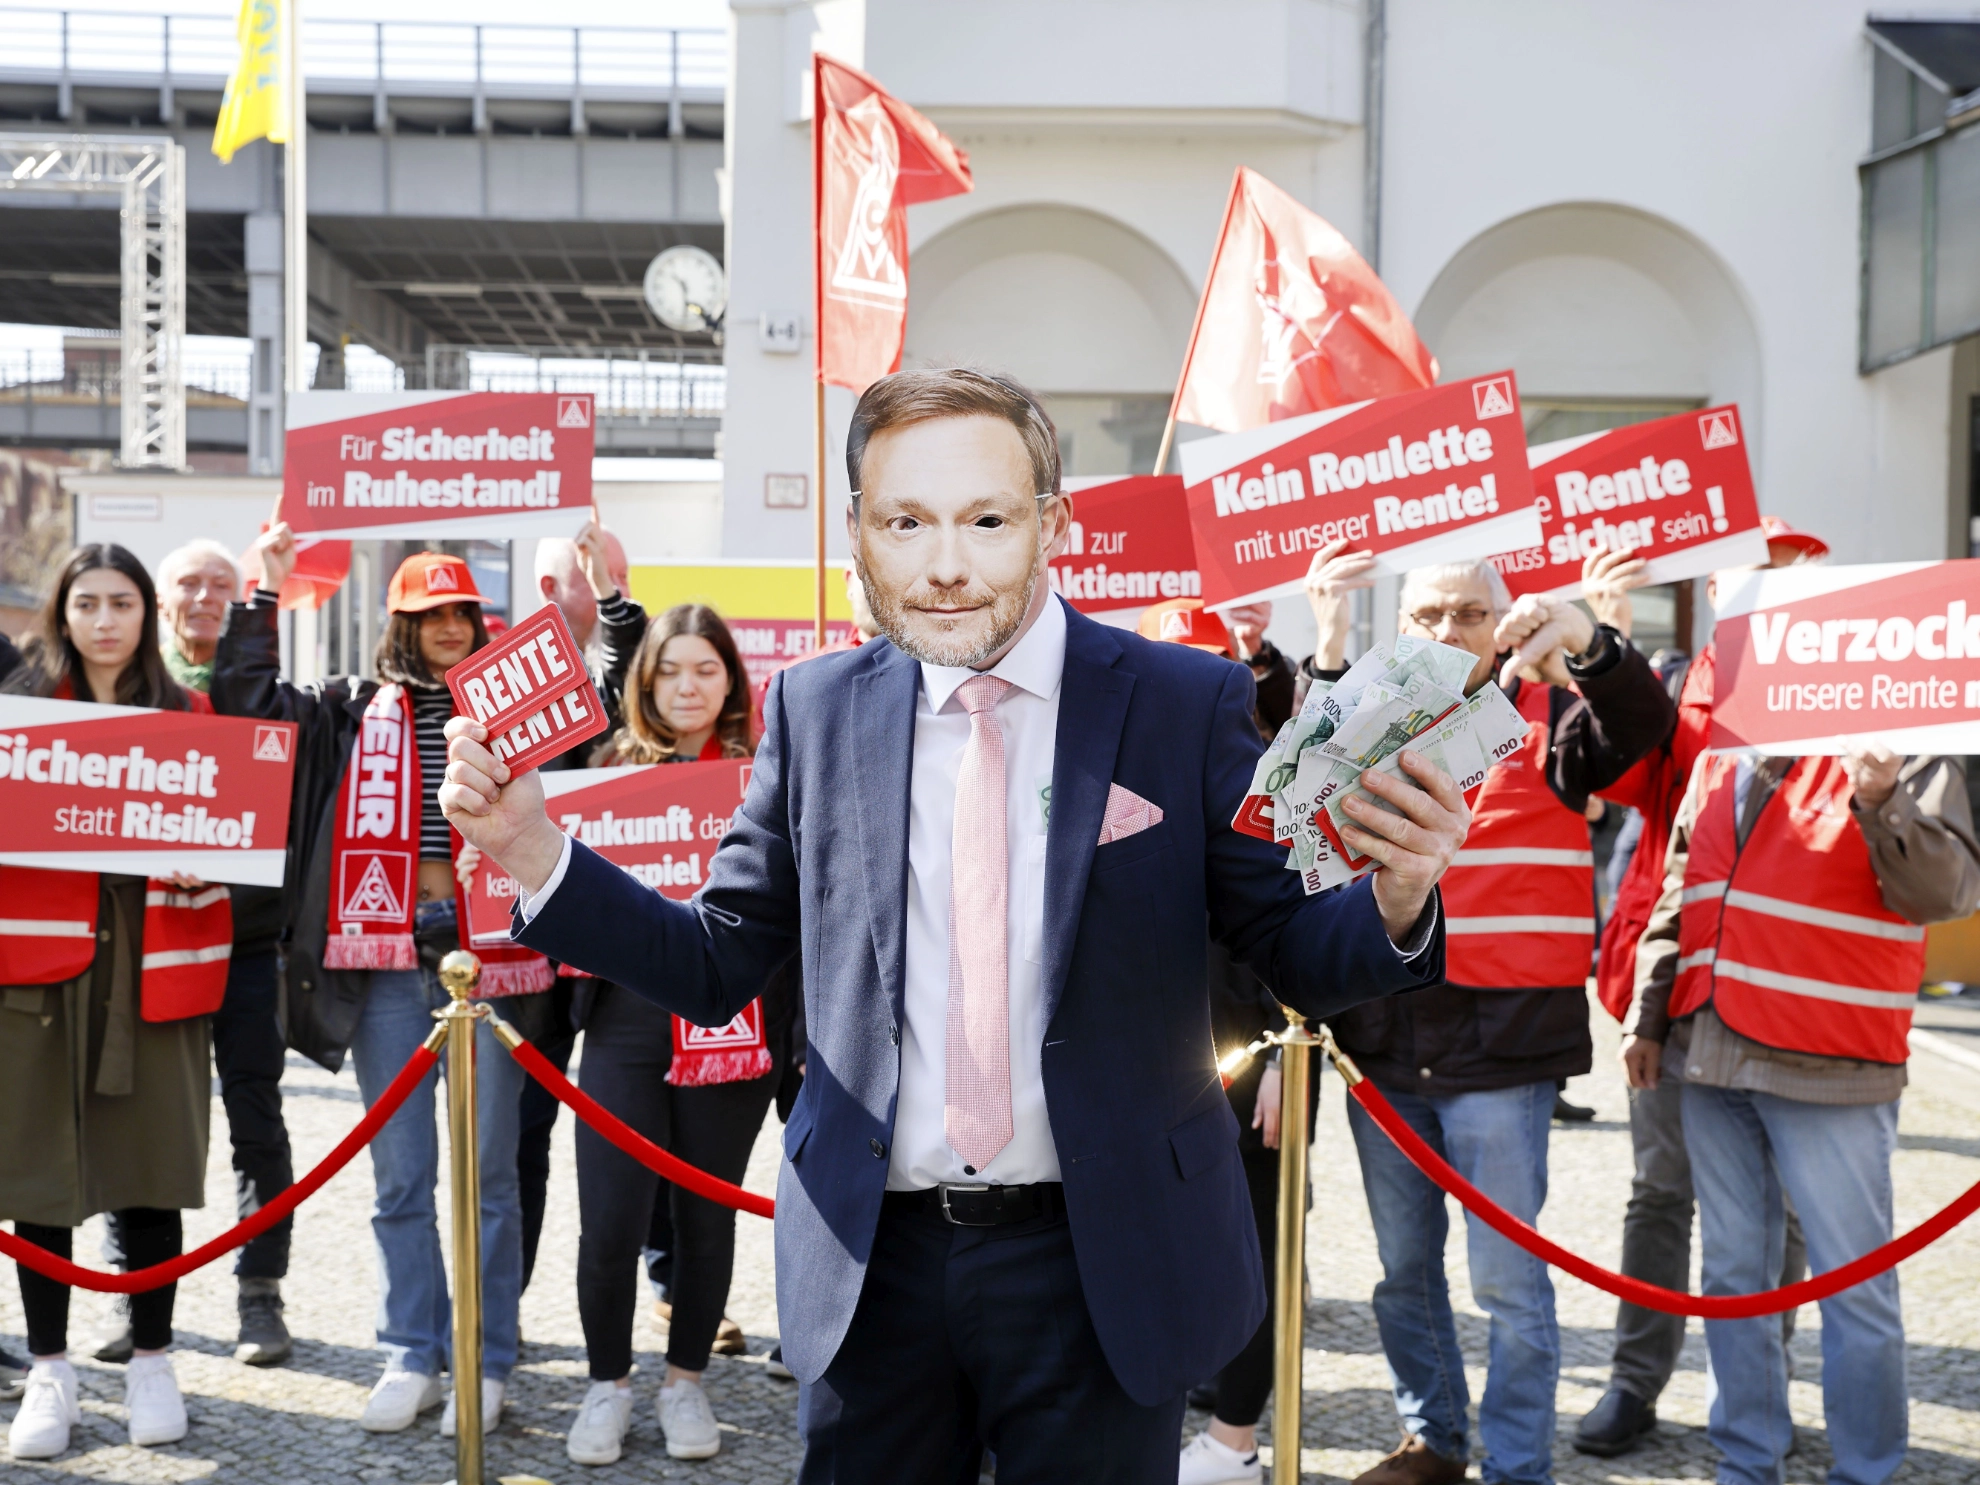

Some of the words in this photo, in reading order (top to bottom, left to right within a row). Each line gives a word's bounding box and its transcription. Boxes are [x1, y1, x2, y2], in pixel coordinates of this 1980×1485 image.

[340, 433, 377, 461] Für
[380, 425, 555, 462] Sicherheit
[307, 481, 335, 508] im
[343, 469, 561, 508] Ruhestand!
[1211, 462, 1305, 518] Kein
[1308, 424, 1494, 497] Roulette
[1555, 455, 1692, 518] Rente
[1234, 530, 1276, 565] mit
[1280, 513, 1371, 555] unserer
[1373, 473, 1500, 536] Rente!
[1090, 531, 1128, 555] zur
[1547, 515, 1656, 565] sicher
[463, 628, 568, 724] RENTE
[1766, 682, 1864, 712] unsere
[1871, 674, 1958, 710] Rente
[1321, 696, 1340, 716] 100
[1492, 738, 1518, 758] 100
[1460, 770, 1485, 790] 100
[53, 804, 117, 837] statt
[121, 800, 257, 849] Risiko!
[560, 805, 694, 847] Zukunft
[1293, 803, 1310, 816] 10
[1276, 823, 1298, 838] 100
[1305, 868, 1321, 892] 100
